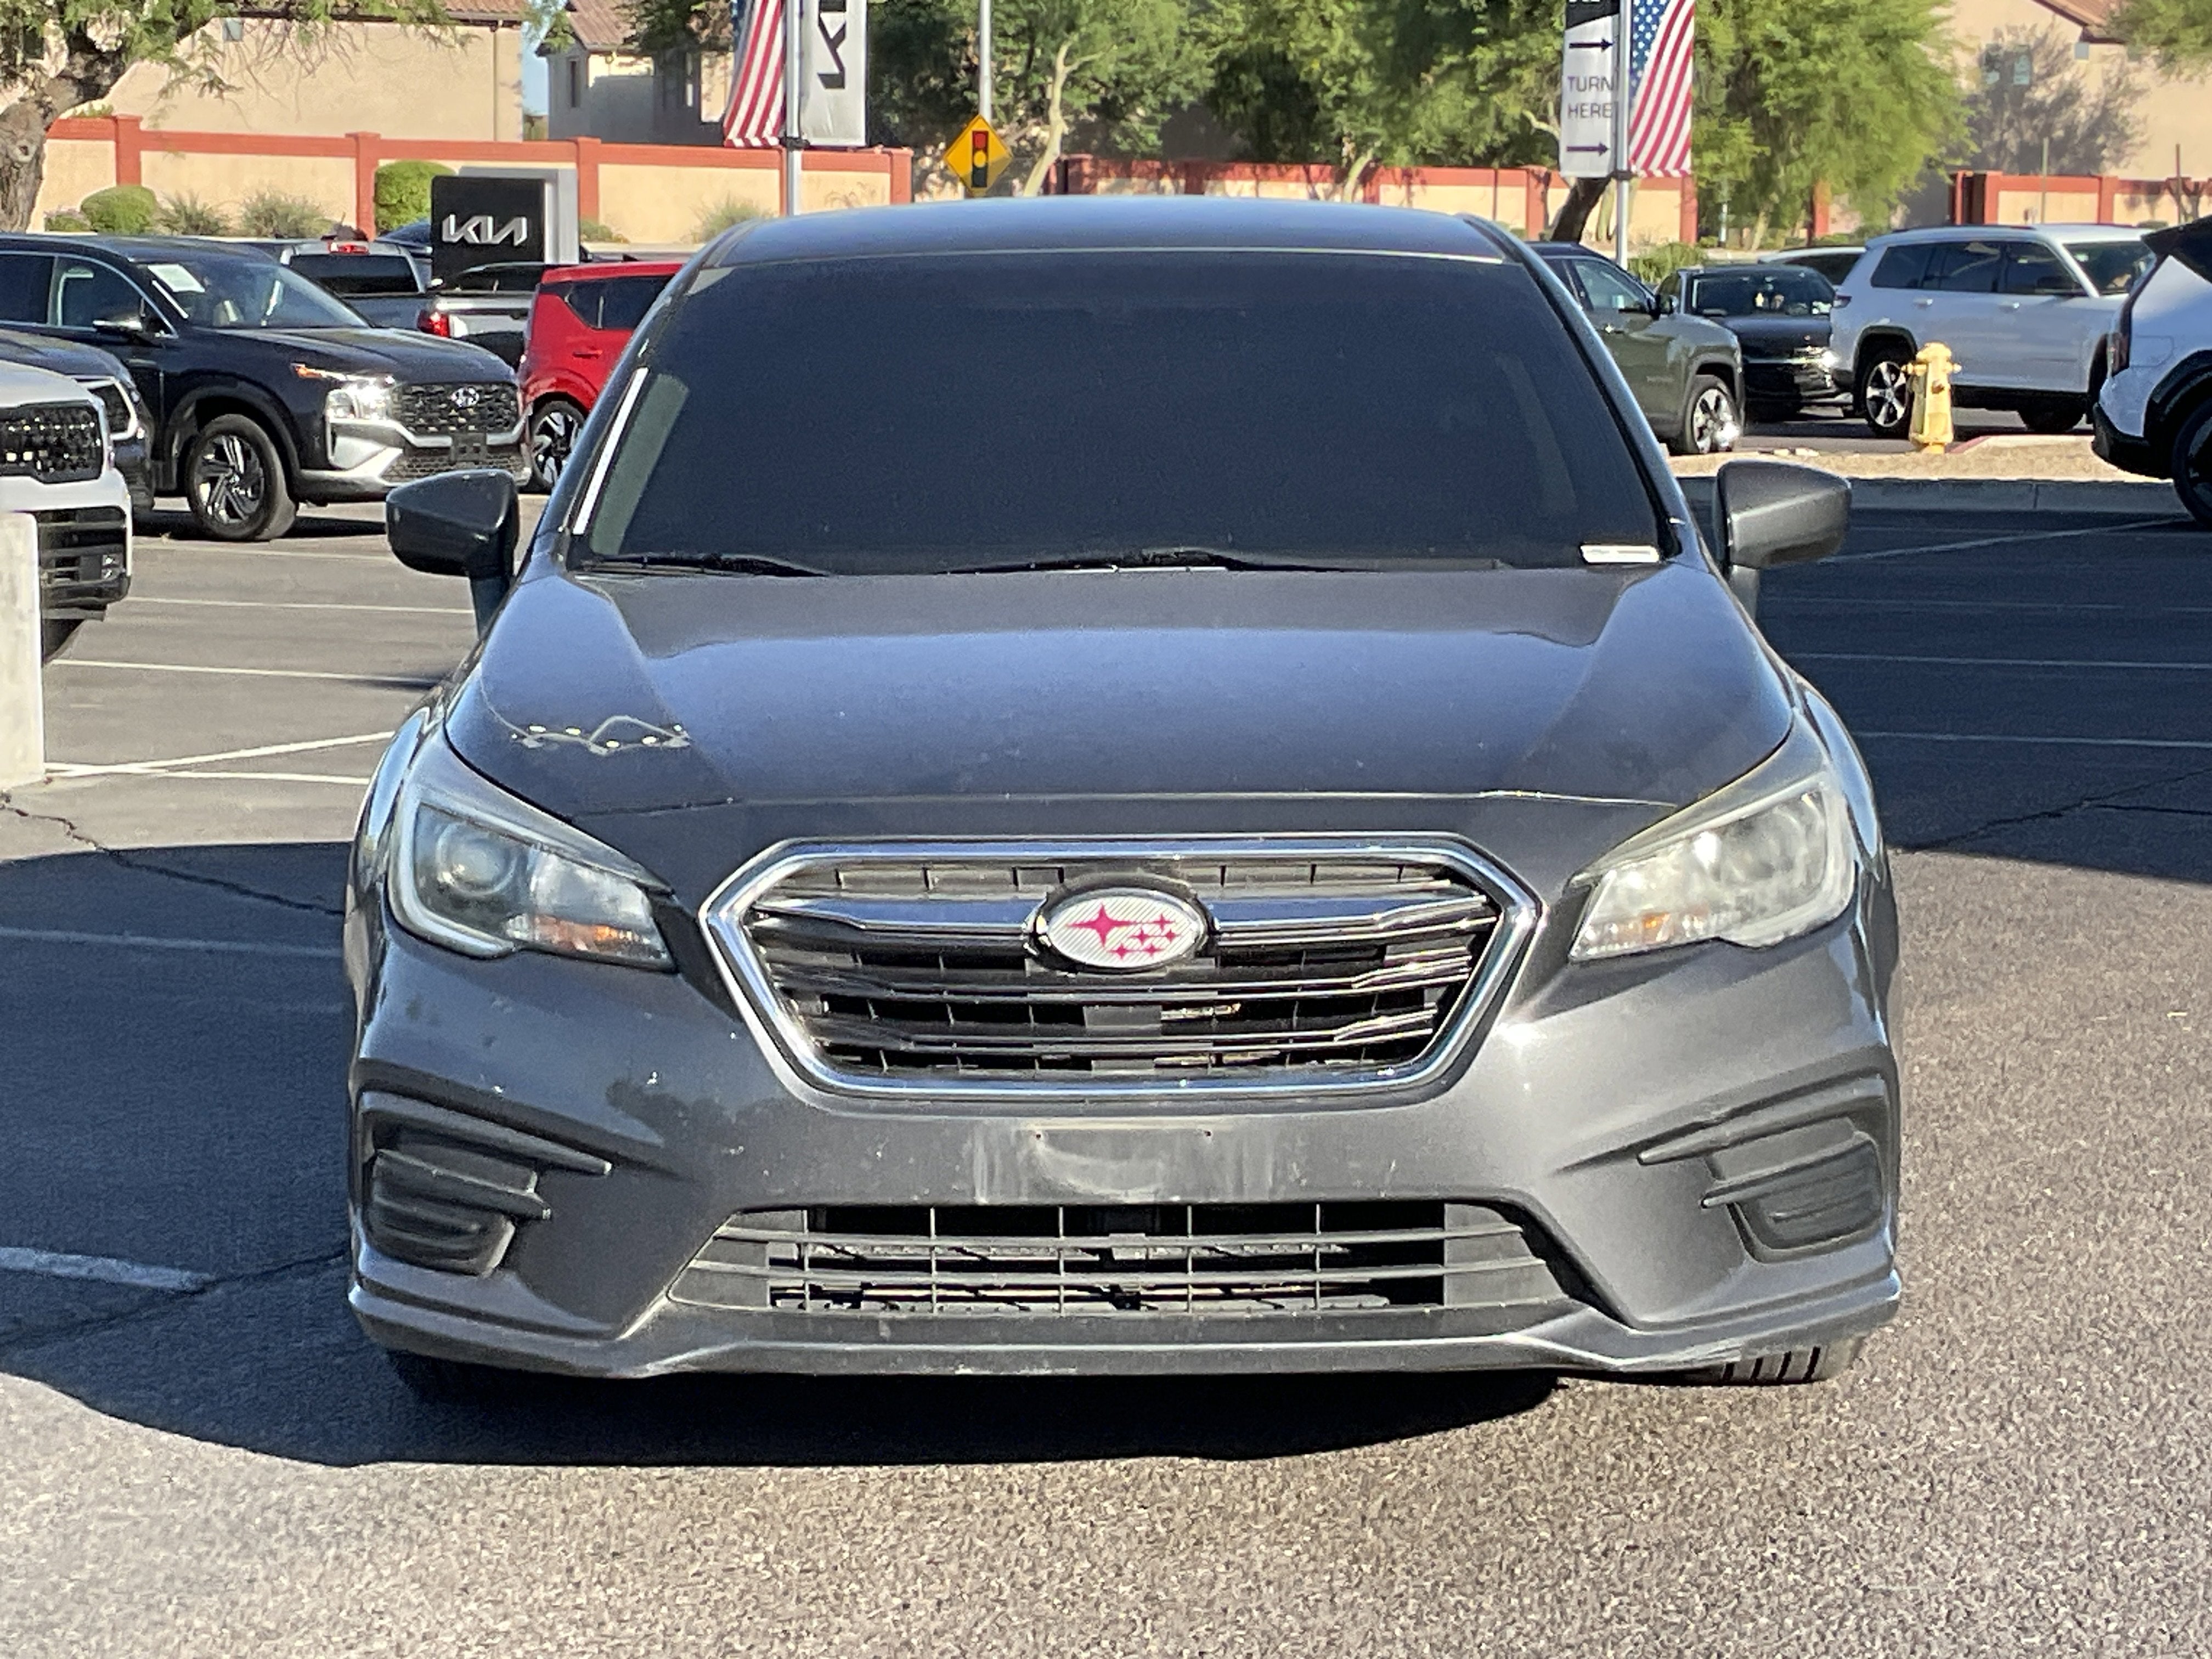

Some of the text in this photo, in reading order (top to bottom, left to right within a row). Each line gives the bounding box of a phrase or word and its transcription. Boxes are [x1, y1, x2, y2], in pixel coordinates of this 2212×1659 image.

[1567, 76, 1614, 92] TURN
[1567, 103, 1613, 119] HERE
[442, 214, 527, 246] KIA
